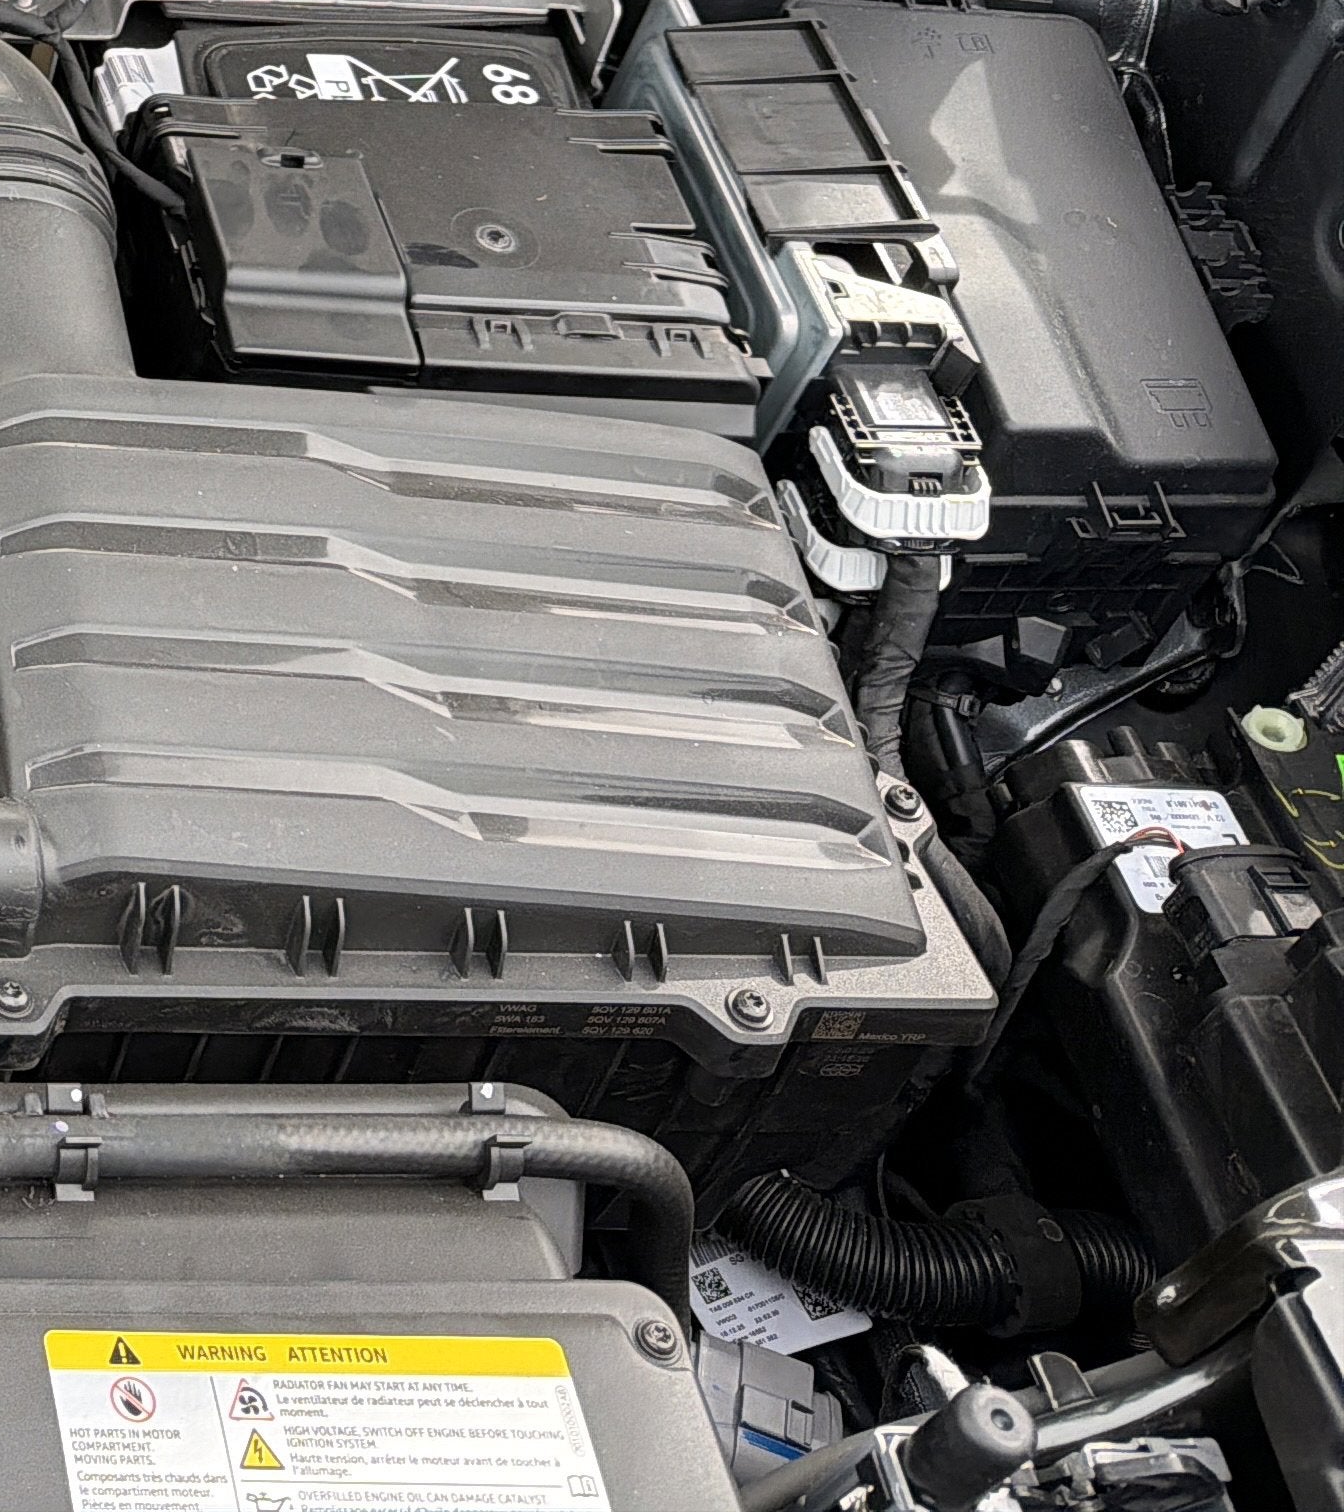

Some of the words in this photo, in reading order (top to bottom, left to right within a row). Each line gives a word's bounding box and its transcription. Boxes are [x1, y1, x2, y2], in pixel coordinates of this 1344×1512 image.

[858, 1032, 898, 1041] Mexico
[176, 1344, 267, 1362] WARNING
[288, 1345, 388, 1364] ATTENTION
[272, 1379, 325, 1391] RADIATOR
[327, 1380, 348, 1391] FAN
[350, 1380, 373, 1391] MAY
[374, 1381, 405, 1392] START
[407, 1382, 420, 1391] AT
[422, 1382, 444, 1392] ANY
[276, 1394, 290, 1405] Le
[292, 1395, 349, 1406] ventilateur
[350, 1395, 365, 1406] de
[366, 1396, 414, 1407] radiateur
[417, 1398, 442, 1409] peut
[443, 1399, 456, 1408] se
[458, 1398, 515, 1409] déclencher
[525, 1399, 549, 1409] tout
[279, 1408, 329, 1418] moment.
[69, 1428, 92, 1439] HOT
[93, 1428, 126, 1439] PARTS
[128, 1429, 140, 1439] IN
[141, 1429, 181, 1440] MOTOR
[283, 1426, 312, 1437] HIGH
[362, 1427, 403, 1438] SWITCH
[404, 1427, 426, 1438] OFF
[427, 1428, 466, 1439] ENGINE
[468, 1428, 509, 1439] BEFORE
[510, 1429, 565, 1441] TOUCHING
[71, 1441, 155, 1453] COMPARTMENT.
[286, 1438, 334, 1449] IGNITION
[74, 1454, 117, 1465] MOVING
[119, 1455, 156, 1466] PARTS.
[289, 1453, 323, 1464] Haute
[324, 1453, 368, 1466] tension,
[408, 1454, 419, 1465] le
[421, 1456, 460, 1466] moteur
[463, 1457, 492, 1466] avant
[495, 1457, 508, 1467] de
[510, 1457, 551, 1468] toucher
[76, 1470, 142, 1484] Composants
[142, 1471, 163, 1483] très
[164, 1472, 202, 1484] chauds
[203, 1473, 228, 1484] dans
[79, 1486, 89, 1496] le
[91, 1486, 169, 1499] compartiment
[298, 1490, 362, 1502] OVERFILLED
[364, 1491, 405, 1503] ENGINE
[407, 1491, 425, 1503] OIL
[426, 1492, 449, 1503] CAN
[451, 1492, 496, 1504] DAMAGE
[497, 1493, 547, 1505] CATALYST
[81, 1499, 115, 1511] Pièces
[118, 1502, 132, 1511] en
